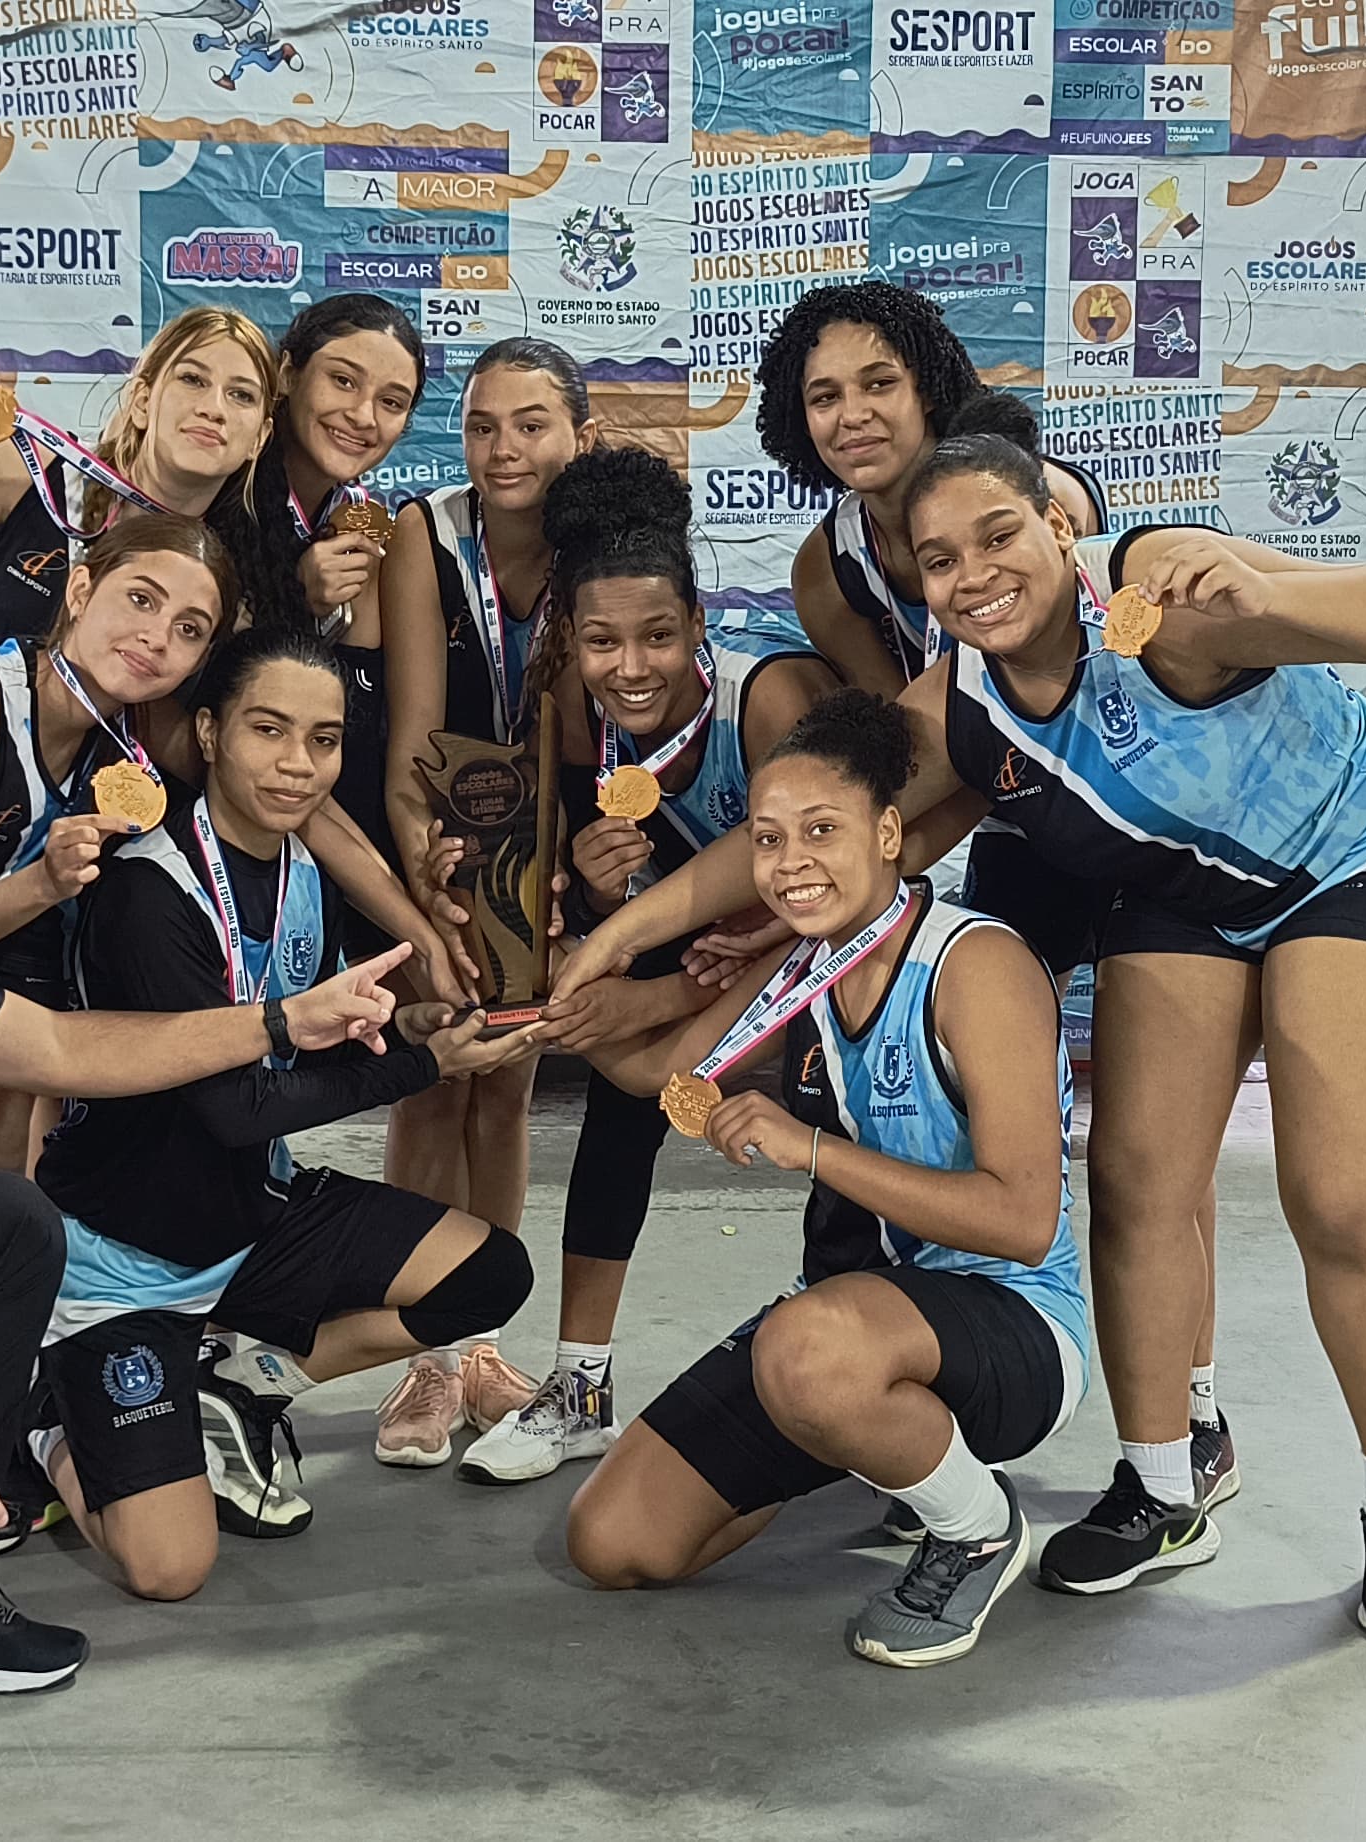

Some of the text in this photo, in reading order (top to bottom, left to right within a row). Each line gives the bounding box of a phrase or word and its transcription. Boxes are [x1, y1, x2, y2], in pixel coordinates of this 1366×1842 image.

[18, 0, 136, 25] ESCOLARES
[609, 17, 662, 32] PRA
[711, 1, 839, 37] joguei pra
[347, 16, 489, 37] ESCOLARES
[890, 9, 1035, 51] SESPORT
[352, 37, 483, 50] DO ESPÍRITO SANTO
[730, 19, 850, 64] pocar!
[1069, 37, 1212, 54] ESCOLAR DO
[22, 54, 136, 86] ESCOLARES
[888, 54, 1033, 67] SECRETARIA DE ESPORTES E LAZER
[1063, 75, 1203, 100] ESPÍRITO SAN
[1150, 97, 1185, 113] TO
[540, 114, 595, 129] POCAR
[363, 177, 495, 201] A MAIOR
[719, 165, 807, 196] ESPÍRITO
[1074, 173, 1134, 190] JOGA
[691, 188, 870, 225] JOGOS ESCOLARES
[367, 223, 495, 249] COMPETIÇÃO
[718, 220, 807, 252] ESPÍRITO
[174, 243, 298, 277] MASSA!
[885, 236, 1010, 270] joguei pra
[1143, 254, 1195, 270] PRA
[1274, 240, 1355, 259] JOGOS
[341, 262, 488, 279] ESCOLAR DO
[690, 244, 869, 282] JOGOS ESCOLARES
[903, 254, 1023, 290] pocar!
[28, 273, 37, 285] DE
[41, 273, 83, 285] ESPORTES
[86, 274, 91, 285] E
[93, 274, 120, 286] LAZER
[1250, 282, 1268, 291] DO
[1273, 281, 1329, 291] ESPÍRITO
[537, 300, 660, 312] GOVERNO DO ESTADO
[717, 279, 805, 309] ESPÍRITO
[427, 299, 480, 316] SAN
[541, 311, 656, 326] DO ESPÍRITO SANTO
[427, 320, 462, 336] TO
[689, 311, 753, 339] JOGOS
[1074, 351, 1128, 366] POCAR
[1070, 397, 1156, 427] ESPÍRITO
[1044, 420, 1221, 456] JOGOS ESCOLARES
[359, 459, 439, 489] oguei
[1160, 449, 1221, 476] SANTO
[1107, 476, 1219, 507] ESCOLARES
[705, 512, 755, 524] SECRETARIA
[757, 513, 766, 524] DE
[770, 513, 811, 524] ESPORTES
[1246, 534, 1361, 545] GOVERNO DO ESTADO
[1321, 548, 1356, 557] SANTO
[211, 862, 240, 948] FINAL ESTADUAL 2025
[805, 970, 828, 991] FINAL
[826, 944, 860, 976] ESTADUAL
[856, 928, 878, 949] 2025
[703, 1057, 722, 1074] 2025
[113, 1401, 176, 1429] BASQUETEBOL
